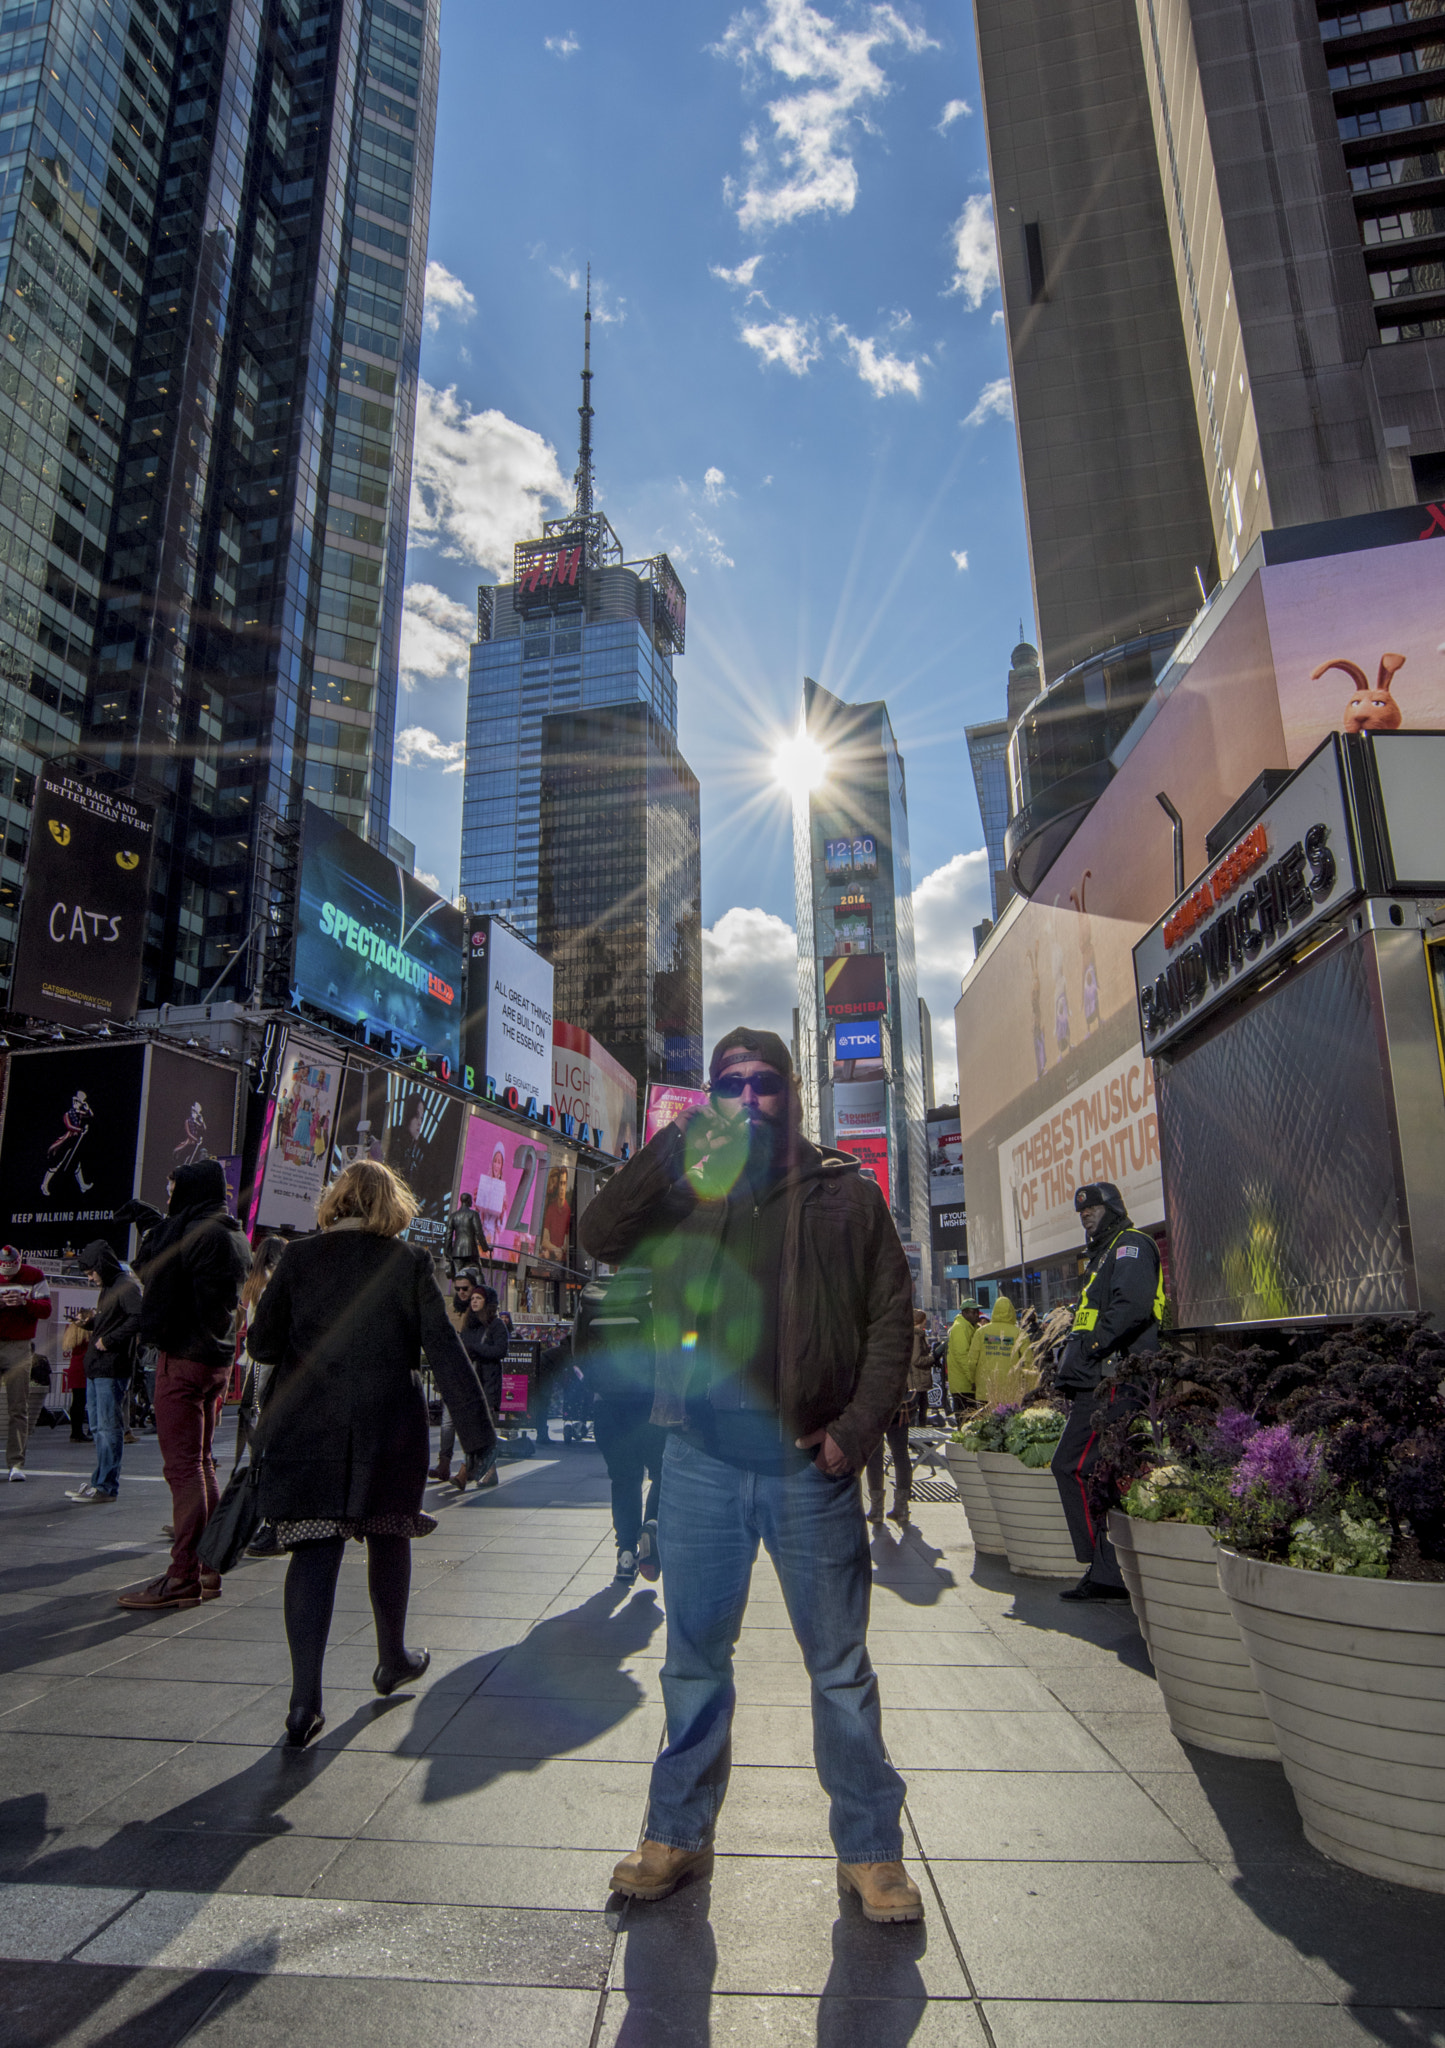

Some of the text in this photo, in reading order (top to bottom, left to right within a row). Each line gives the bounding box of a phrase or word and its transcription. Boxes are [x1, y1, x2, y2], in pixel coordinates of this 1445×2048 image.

[518, 545, 582, 594] H&M
[62, 776, 84, 793] IT'S
[85, 786, 114, 806] BACK
[115, 800, 138, 816] AND
[88, 798, 120, 819] THAN
[827, 839, 874, 857] 12:20
[840, 894, 865, 905] 2016
[49, 901, 122, 945] CATS
[1141, 822, 1337, 1034] SANDWICHES
[472, 948, 485, 958] LG
[42, 982, 113, 1008] CATSBROADWAY.COM
[494, 979, 552, 1026] ALL GREAT THINGS
[826, 1001, 886, 1016] TOSHIBA
[502, 1003, 545, 1040] ARE BUILT ON
[502, 1022, 545, 1058] THE ESSENCE
[848, 1034, 878, 1045] TDK
[504, 1072, 540, 1097] LG SIGNATURE
[463, 1063, 604, 1149] BROADWAY
[661, 1101, 685, 1111] NEW
[1083, 1057, 1157, 1143] MUSICA
[656, 1119, 671, 1128] EV
[658, 1109, 679, 1119] YEA
[947, 1134, 963, 1143] DECE
[1020, 1112, 1162, 1221] OF THIS CENTUR
[505, 1144, 549, 1237] 21
[11, 1209, 114, 1223] KEEP WALKING AMERICA
[943, 1219, 959, 1227] WISH
[20, 1248, 59, 1258] JOHNNIE
